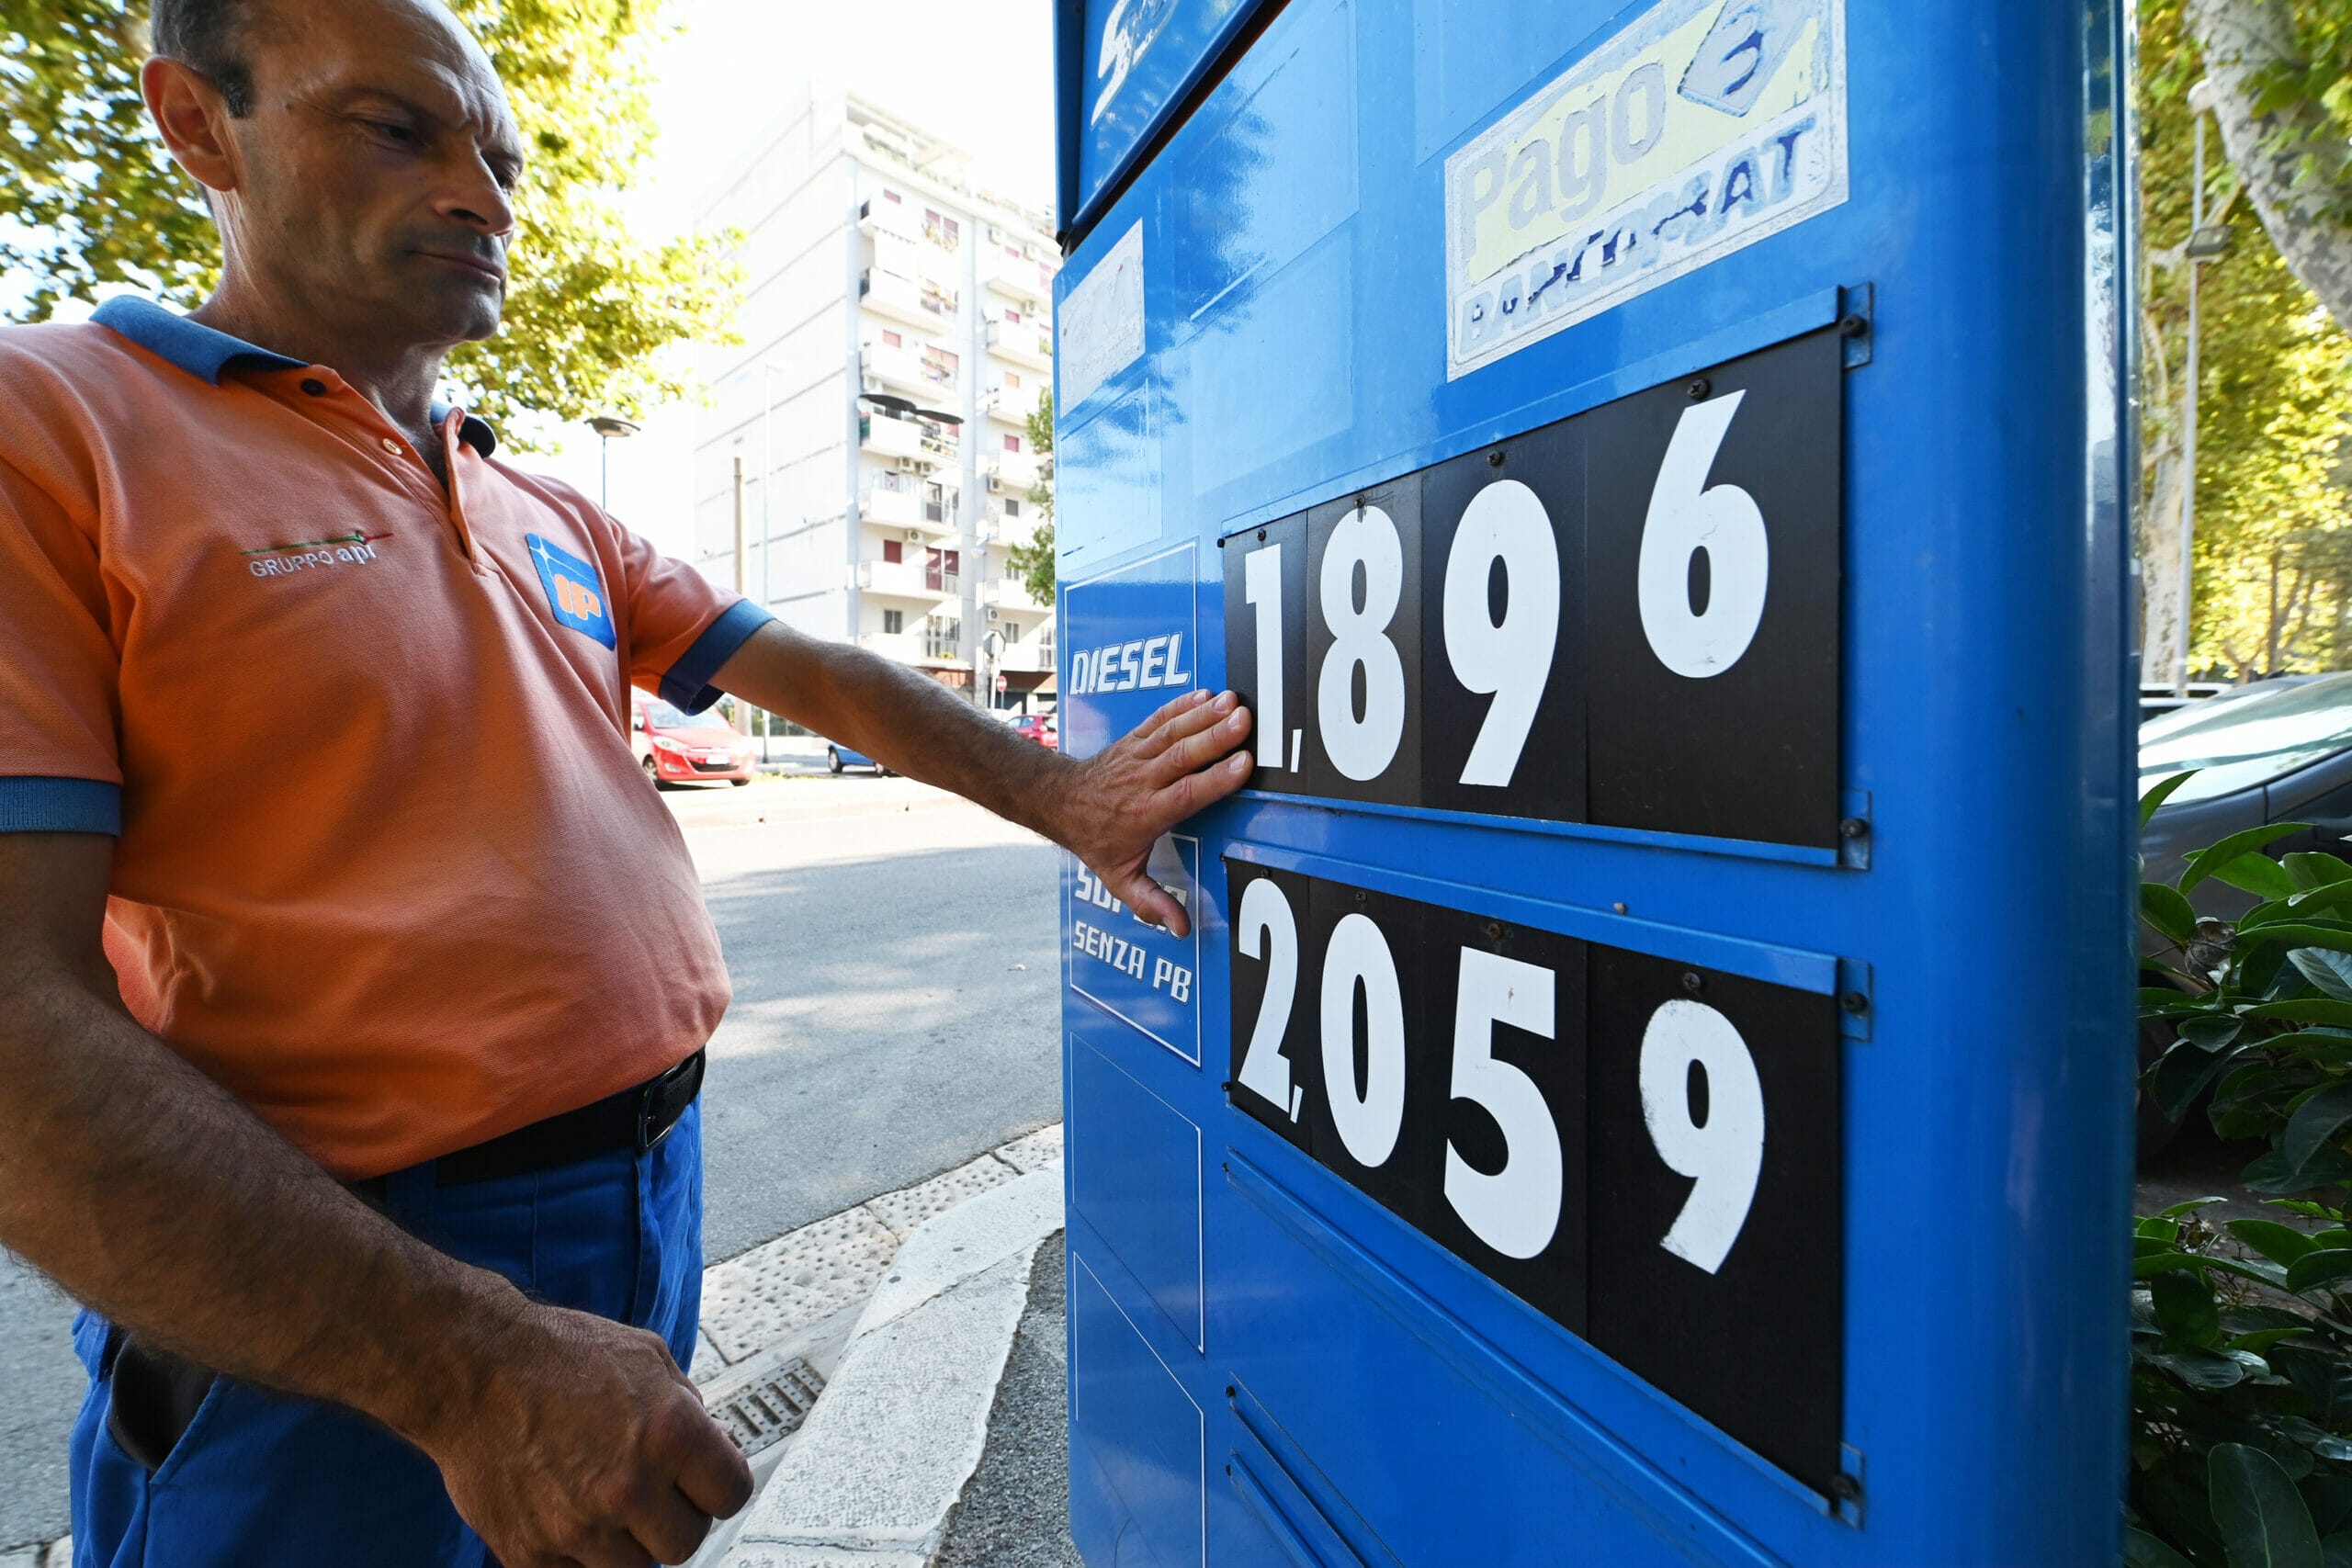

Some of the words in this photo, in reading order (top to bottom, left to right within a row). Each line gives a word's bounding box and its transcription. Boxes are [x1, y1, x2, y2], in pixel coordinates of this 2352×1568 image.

[1464, 59, 1667, 261] Pago
[250, 550, 334, 578] GRUPPO
[553, 573, 602, 621] IP
[1244, 388, 1770, 788] 1,896
[1069, 631, 1192, 696] DIESEL
[1073, 920, 1147, 981] SENZA
[1152, 956, 1193, 1005] PB
[1237, 876, 1766, 1275] 2,059
